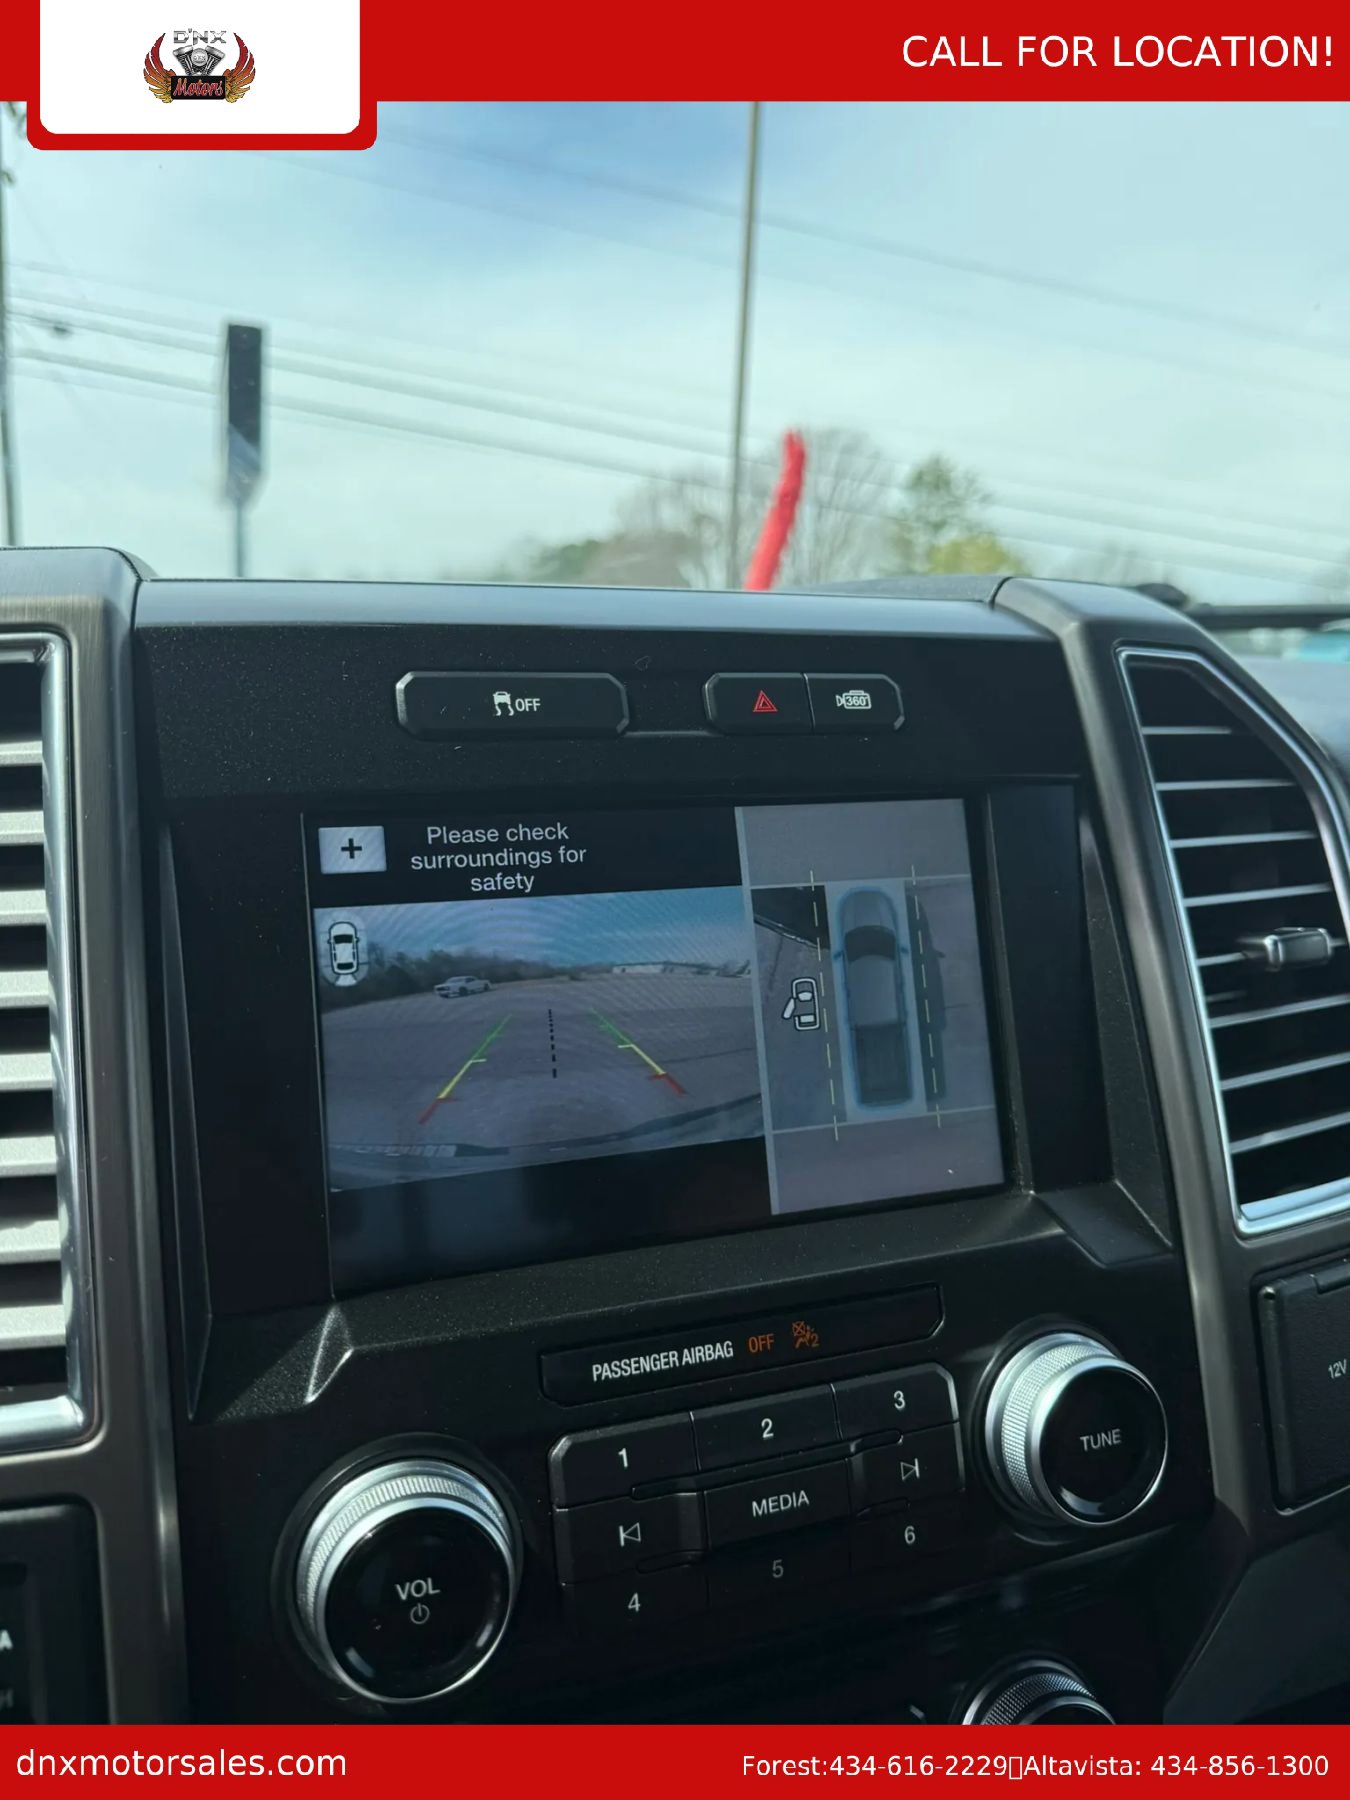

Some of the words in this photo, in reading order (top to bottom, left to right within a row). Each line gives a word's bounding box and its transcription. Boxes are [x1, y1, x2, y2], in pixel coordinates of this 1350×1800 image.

[514, 697, 541, 712] OFF
[426, 826, 500, 845] Please
[505, 822, 569, 842] check
[410, 846, 552, 869] surroundings
[558, 845, 587, 863] for
[470, 871, 535, 893] safety
[592, 1350, 680, 1382] PASSENGER
[681, 1340, 734, 1366] AIRBAG
[748, 1333, 774, 1353] OFF
[1328, 1358, 1347, 1379] 12V
[893, 1390, 906, 1411] 3
[761, 1417, 774, 1439] 2
[1079, 1428, 1121, 1451] TUNE
[618, 1447, 629, 1468] 1
[751, 1490, 810, 1517] MEDIA
[904, 1525, 916, 1545] 6
[772, 1559, 784, 1579] 5
[395, 1577, 441, 1601] VOL
[627, 1592, 641, 1612] 4
